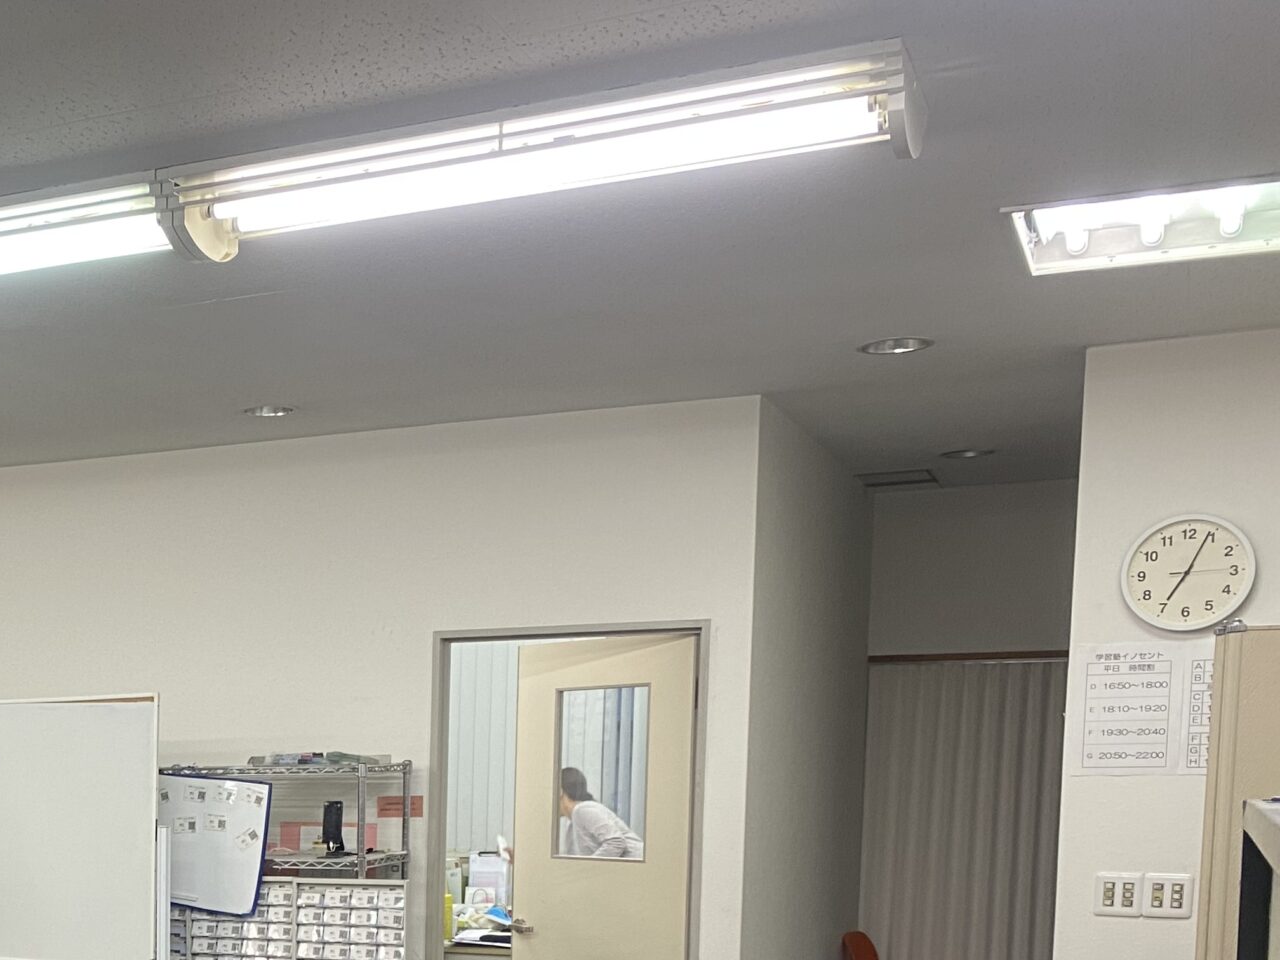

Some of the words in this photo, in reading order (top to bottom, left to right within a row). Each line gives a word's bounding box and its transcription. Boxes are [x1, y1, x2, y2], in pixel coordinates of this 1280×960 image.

[1181, 529, 1197, 539] 12
[1161, 536, 1173, 547] 11
[1144, 551, 1158, 562] 10
[1224, 546, 1234, 557] 2
[1229, 565, 1239, 576] 3
[1137, 571, 1146, 582] 9
[1143, 590, 1152, 601] 8
[1222, 585, 1231, 595] 4
[1159, 602, 1168, 613] 7
[1204, 600, 1213, 611] 5
[1181, 607, 1190, 617] 6
[1095, 652, 1164, 661] 学習塾イノセント
[1192, 716, 1199, 724] E
